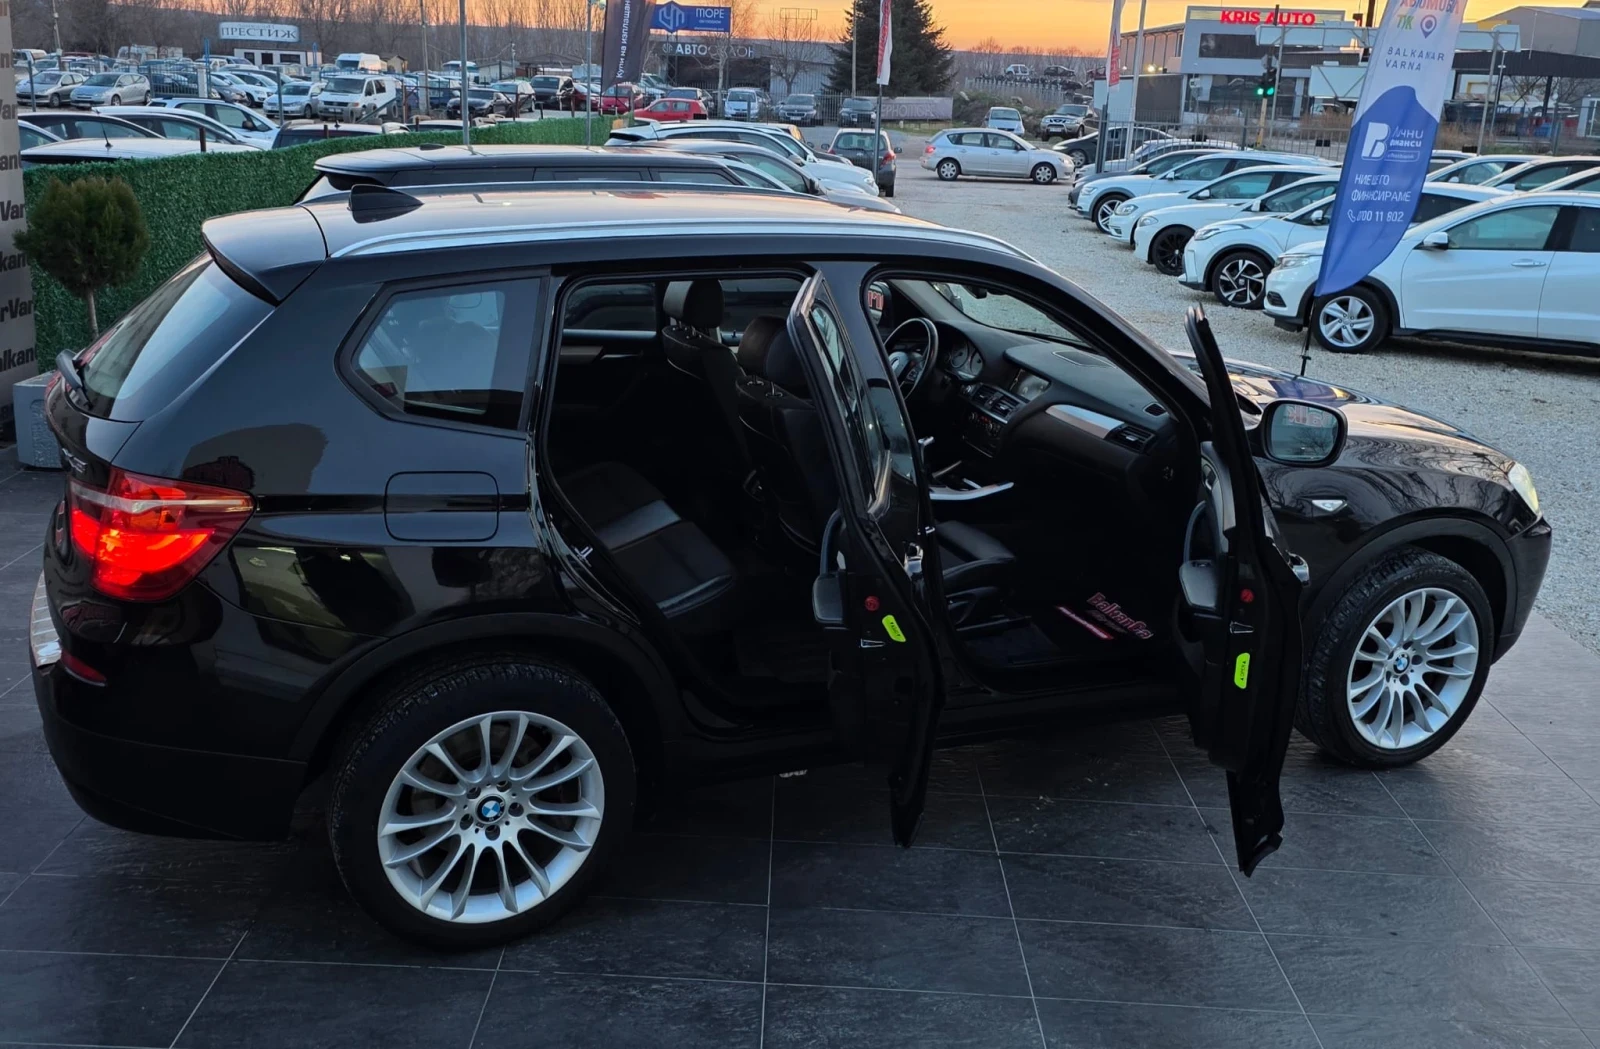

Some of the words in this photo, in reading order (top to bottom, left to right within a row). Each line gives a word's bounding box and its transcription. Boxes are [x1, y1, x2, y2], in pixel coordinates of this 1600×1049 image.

[1220, 10, 1261, 25] KRIS
[1265, 12, 1315, 26] AUTO
[221, 27, 297, 39] ПРЕСТИЖ
[676, 43, 756, 58] АВТОСЛОН
[1385, 59, 1422, 71] VARNA
[1354, 173, 1371, 186] НИЕ
[1375, 211, 1384, 222] 11
[1386, 211, 1405, 223] 802
